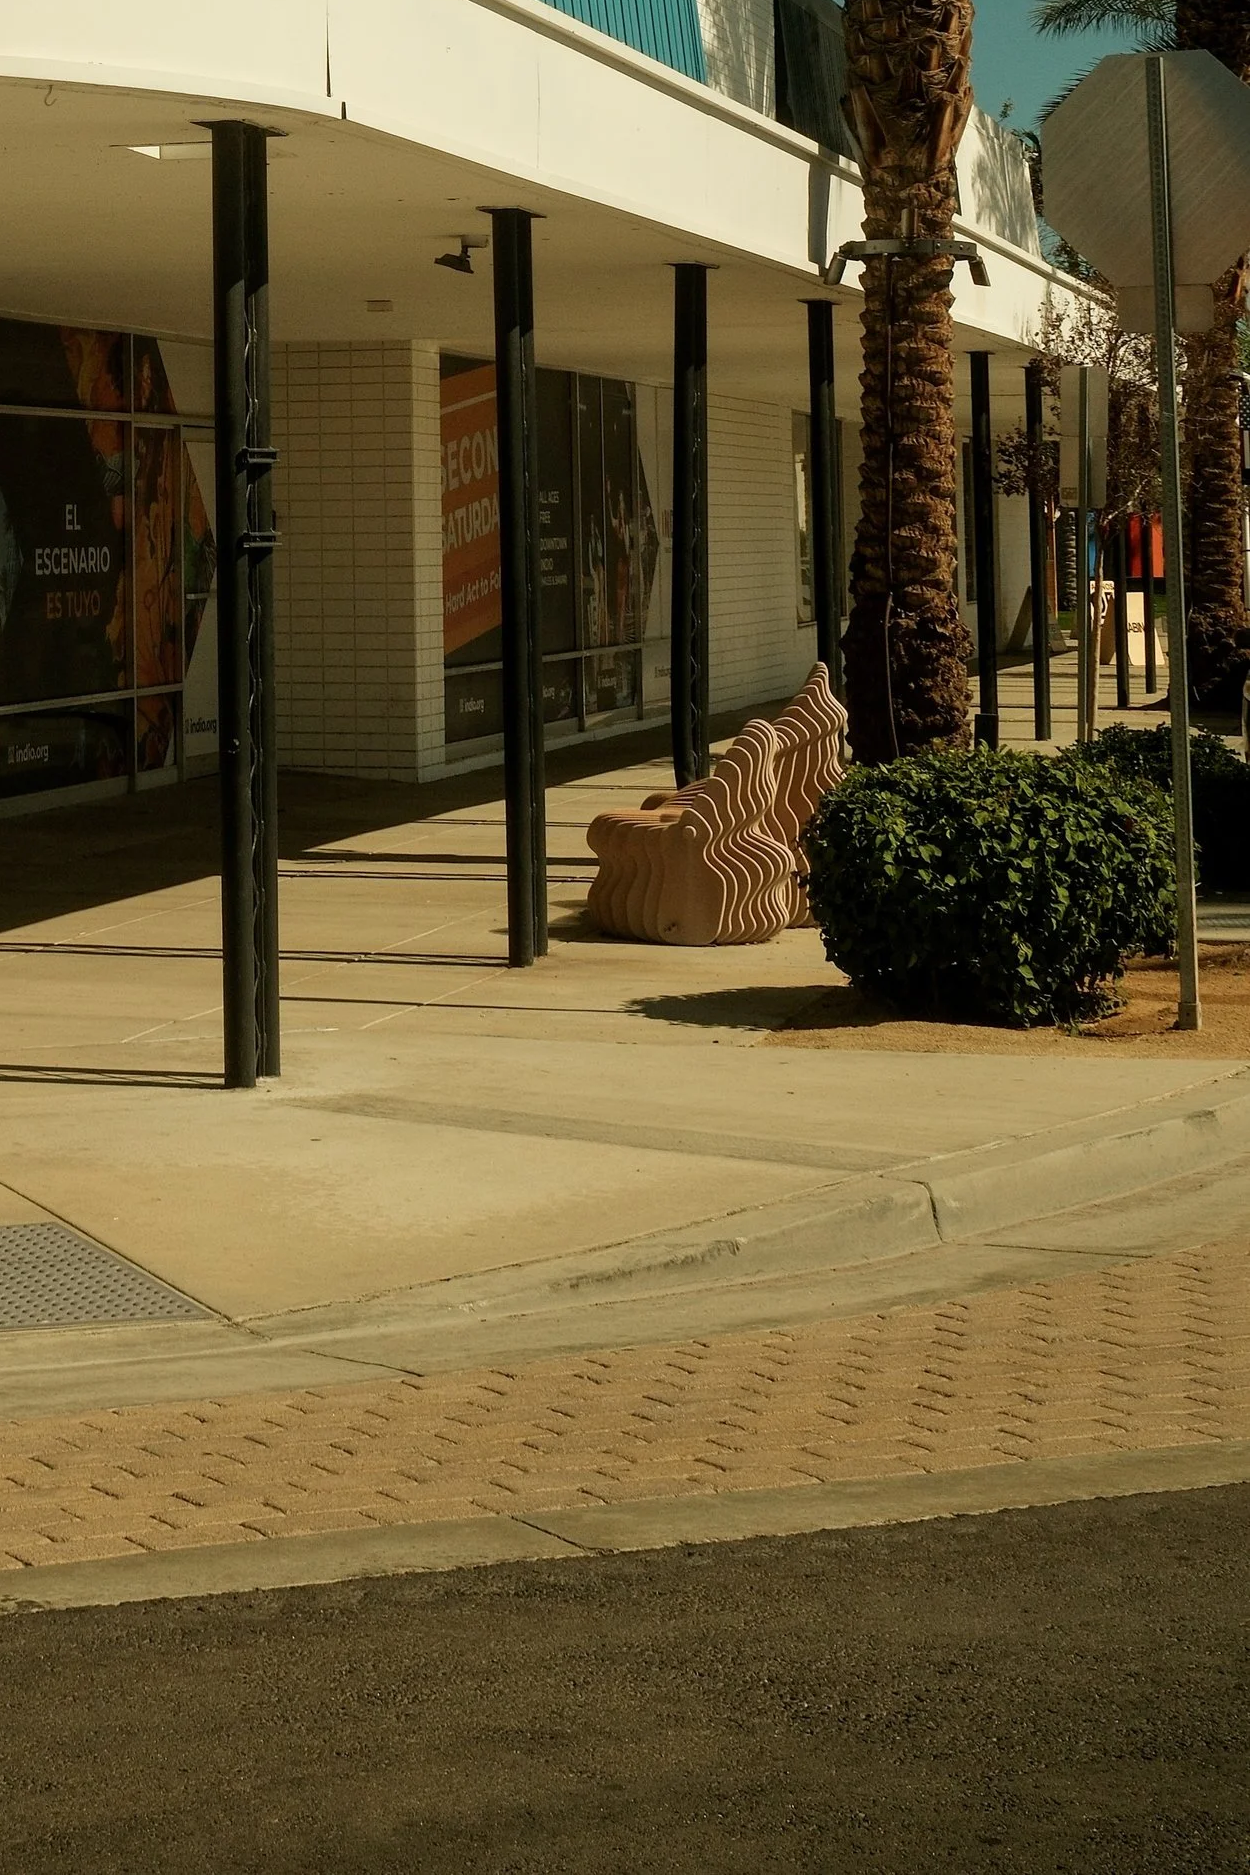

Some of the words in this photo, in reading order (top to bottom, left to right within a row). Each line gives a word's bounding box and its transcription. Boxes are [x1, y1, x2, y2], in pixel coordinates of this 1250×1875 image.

[441, 425, 499, 493] ECON
[65, 504, 81, 530] EL
[442, 492, 501, 553] ATURDA
[34, 546, 111, 575] ESCENARIO
[46, 592, 63, 619] ES
[66, 590, 101, 617] TUYO
[445, 584, 465, 616] Hard
[466, 579, 479, 606] Act
[480, 577, 489, 596] to
[189, 718, 217, 734] indio.org
[15, 743, 49, 763] indio.org
